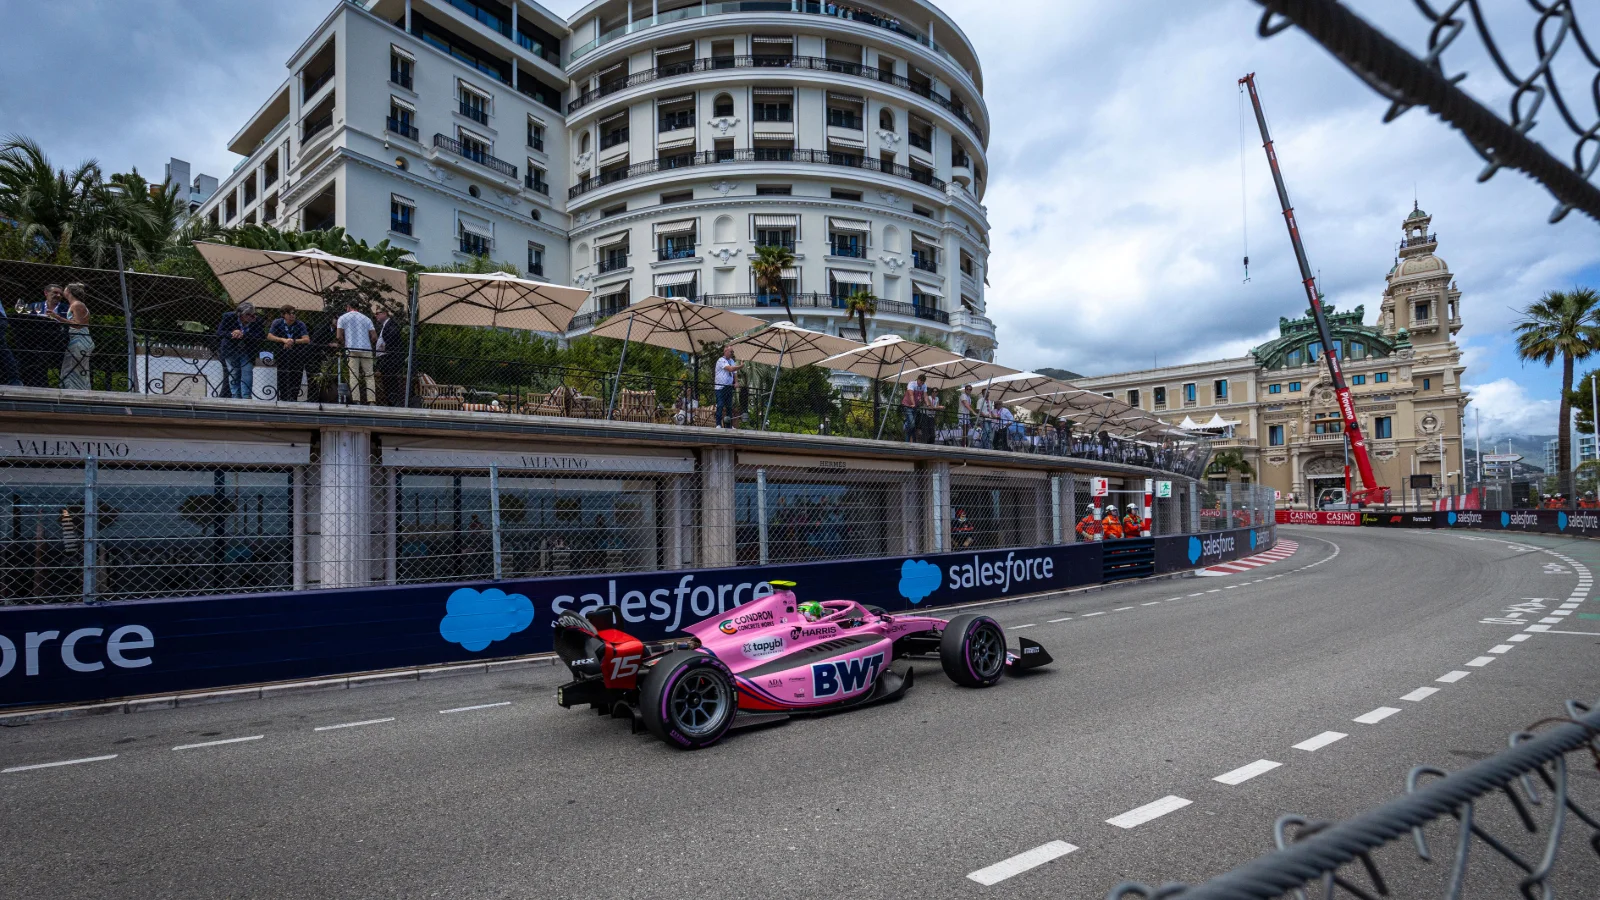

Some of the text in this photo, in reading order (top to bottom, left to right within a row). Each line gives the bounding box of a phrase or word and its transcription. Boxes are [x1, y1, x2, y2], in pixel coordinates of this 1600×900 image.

[1340, 391, 1354, 420] Piovano
[17, 440, 129, 457] VALENTINO
[521, 456, 587, 468] VALENTINO
[1290, 512, 1317, 520] CASINO
[1327, 513, 1356, 521] CASINO
[1457, 511, 1482, 525] salesforce
[1510, 511, 1538, 528] salesforce
[1568, 511, 1598, 532] salesforce
[1202, 533, 1235, 559] salesforce
[949, 552, 1054, 593] salesforce
[734, 610, 774, 625] CONDRON
[737, 620, 775, 631] CONCRETE WORKS
[801, 626, 837, 637] HARRIS
[753, 637, 783, 651] tapybl
[610, 655, 641, 681] 15
[810, 652, 885, 698] BWT
